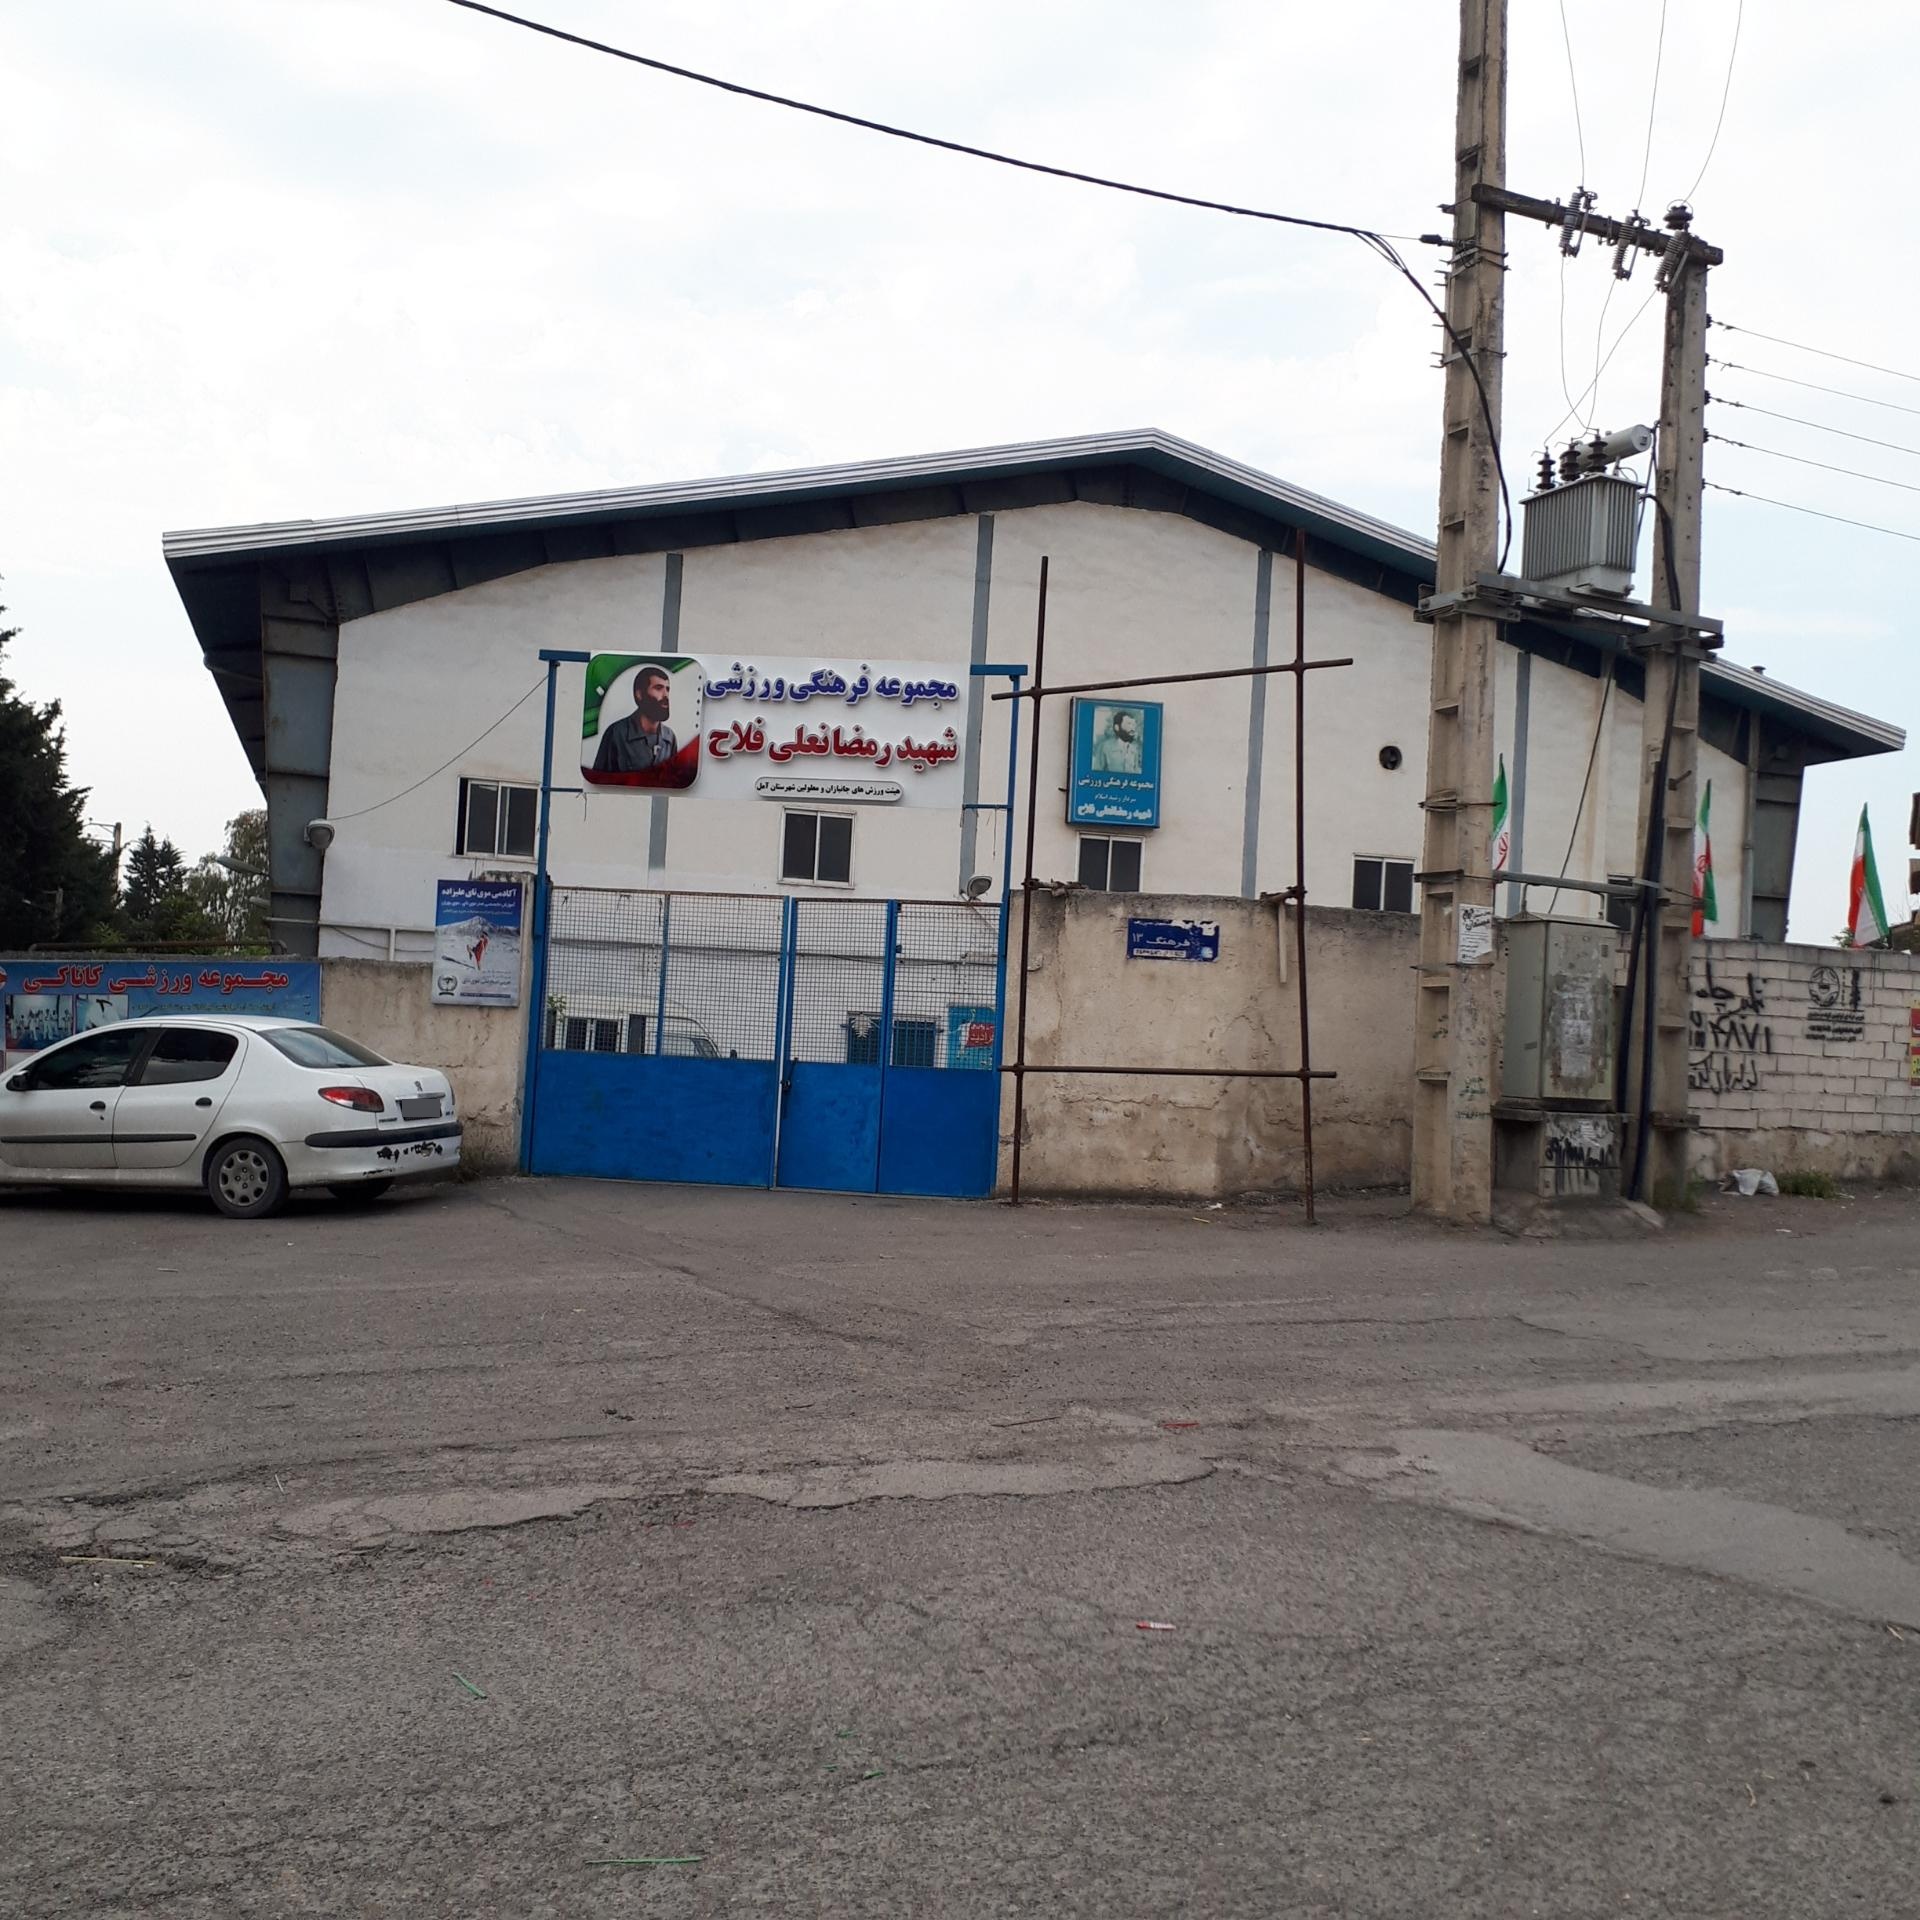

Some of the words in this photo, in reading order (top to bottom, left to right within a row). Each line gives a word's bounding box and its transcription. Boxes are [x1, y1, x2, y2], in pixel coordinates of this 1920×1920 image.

[704, 662, 785, 700] ورزشی
[788, 663, 870, 705] فرهنگی
[875, 675, 958, 709] مجموعه
[708, 716, 765, 758] فلاح
[896, 727, 959, 771] شهید
[756, 781, 769, 791] آمل
[770, 782, 796, 793] شهرستان
[1078, 774, 1102, 788] ورزشی
[1102, 776, 1129, 789] فرهنگی
[1129, 779, 1154, 791] مجموعه
[796, 783, 819, 793] معلولین
[825, 784, 850, 795] جانبازان
[851, 785, 864, 795] های
[865, 786, 884, 796] ورزش
[107, 964, 193, 993] ورزشی
[198, 969, 288, 993] مجموعه
